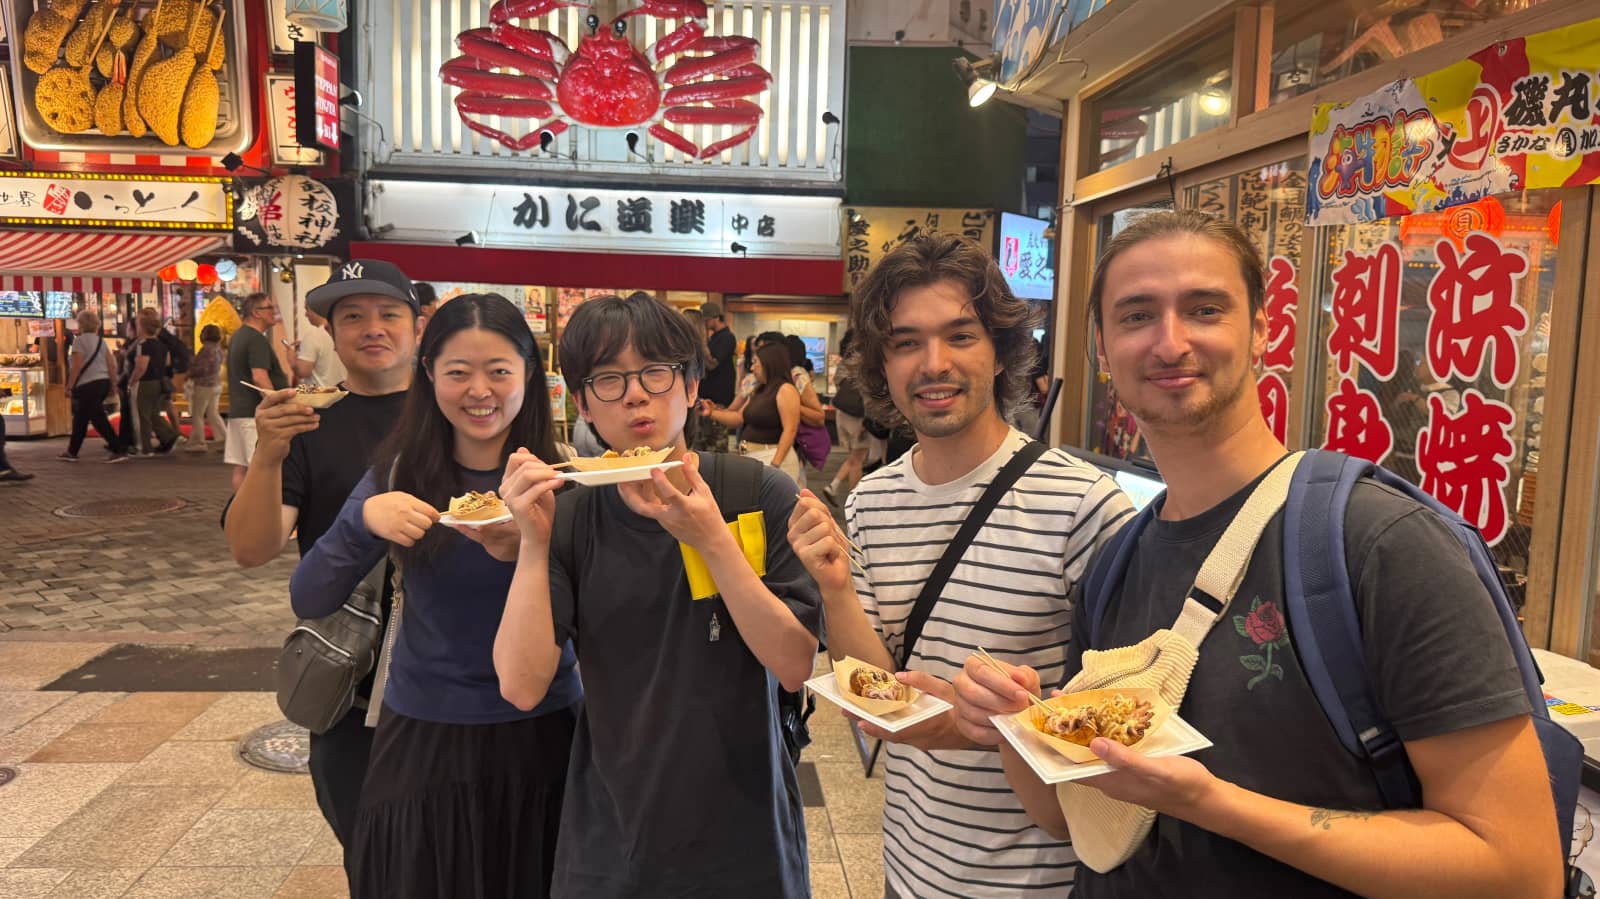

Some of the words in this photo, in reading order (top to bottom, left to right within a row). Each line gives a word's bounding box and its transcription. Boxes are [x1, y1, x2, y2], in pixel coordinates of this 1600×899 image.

[1504, 71, 1600, 127] 磯丸
[513, 192, 706, 234] かに道楽
[731, 213, 776, 237] 中店
[1418, 233, 1528, 545] 浜焼
